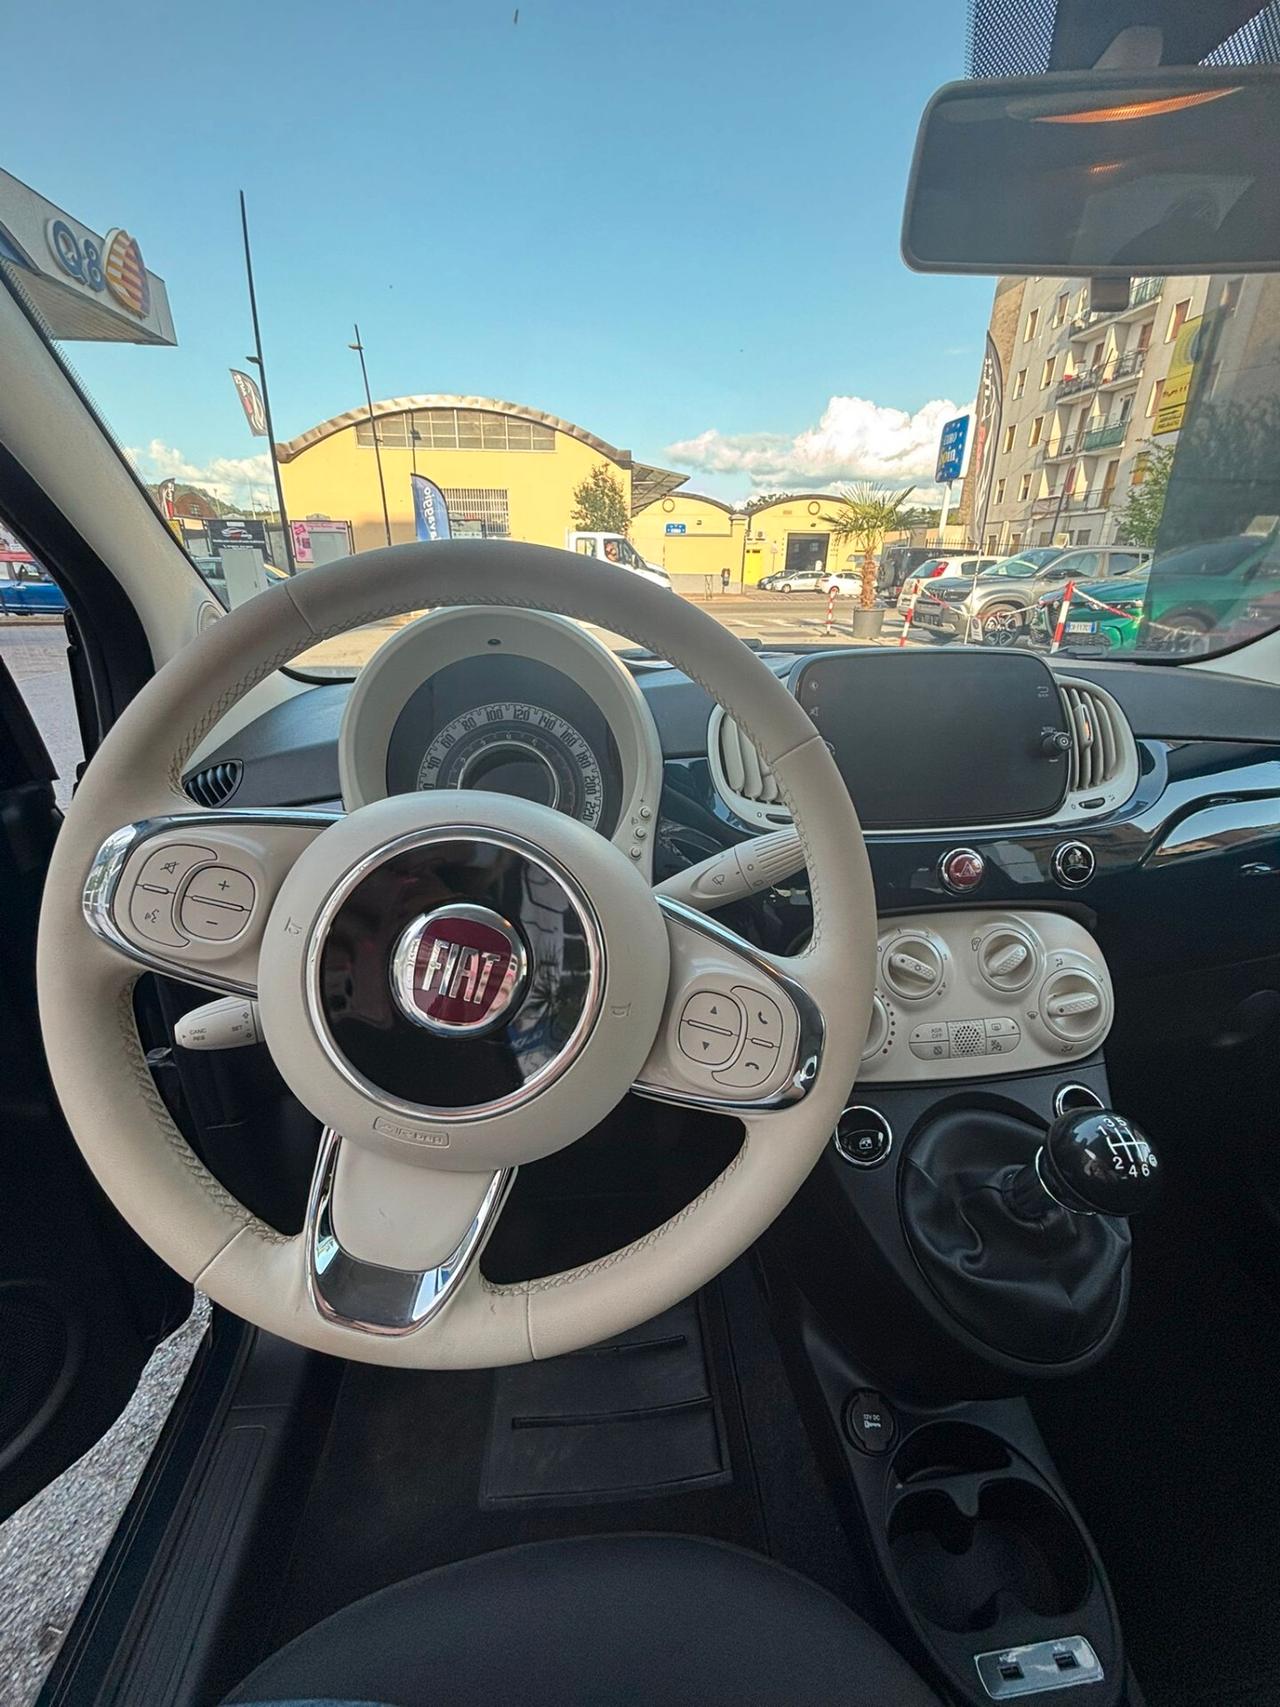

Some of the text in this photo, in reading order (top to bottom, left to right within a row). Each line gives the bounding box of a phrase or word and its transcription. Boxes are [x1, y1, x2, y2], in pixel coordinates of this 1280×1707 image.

[47, 219, 106, 292] Q8
[460, 716, 477, 731] 80
[486, 708, 503, 721] 100
[513, 709, 530, 721] 120
[538, 712, 556, 731] 140
[440, 733, 457, 749] 60
[559, 727, 576, 748] 160
[427, 756, 442, 770] 40
[576, 749, 592, 770] 180
[584, 776, 597, 796] 200
[582, 801, 597, 822] 220
[422, 939, 501, 1005] FIAT
[1103, 1117, 1116, 1128] 3
[1113, 1115, 1128, 1127] 5
[1112, 1156, 1124, 1170] 2
[1128, 1164, 1139, 1178] 4
[1141, 1163, 1150, 1177] 6
